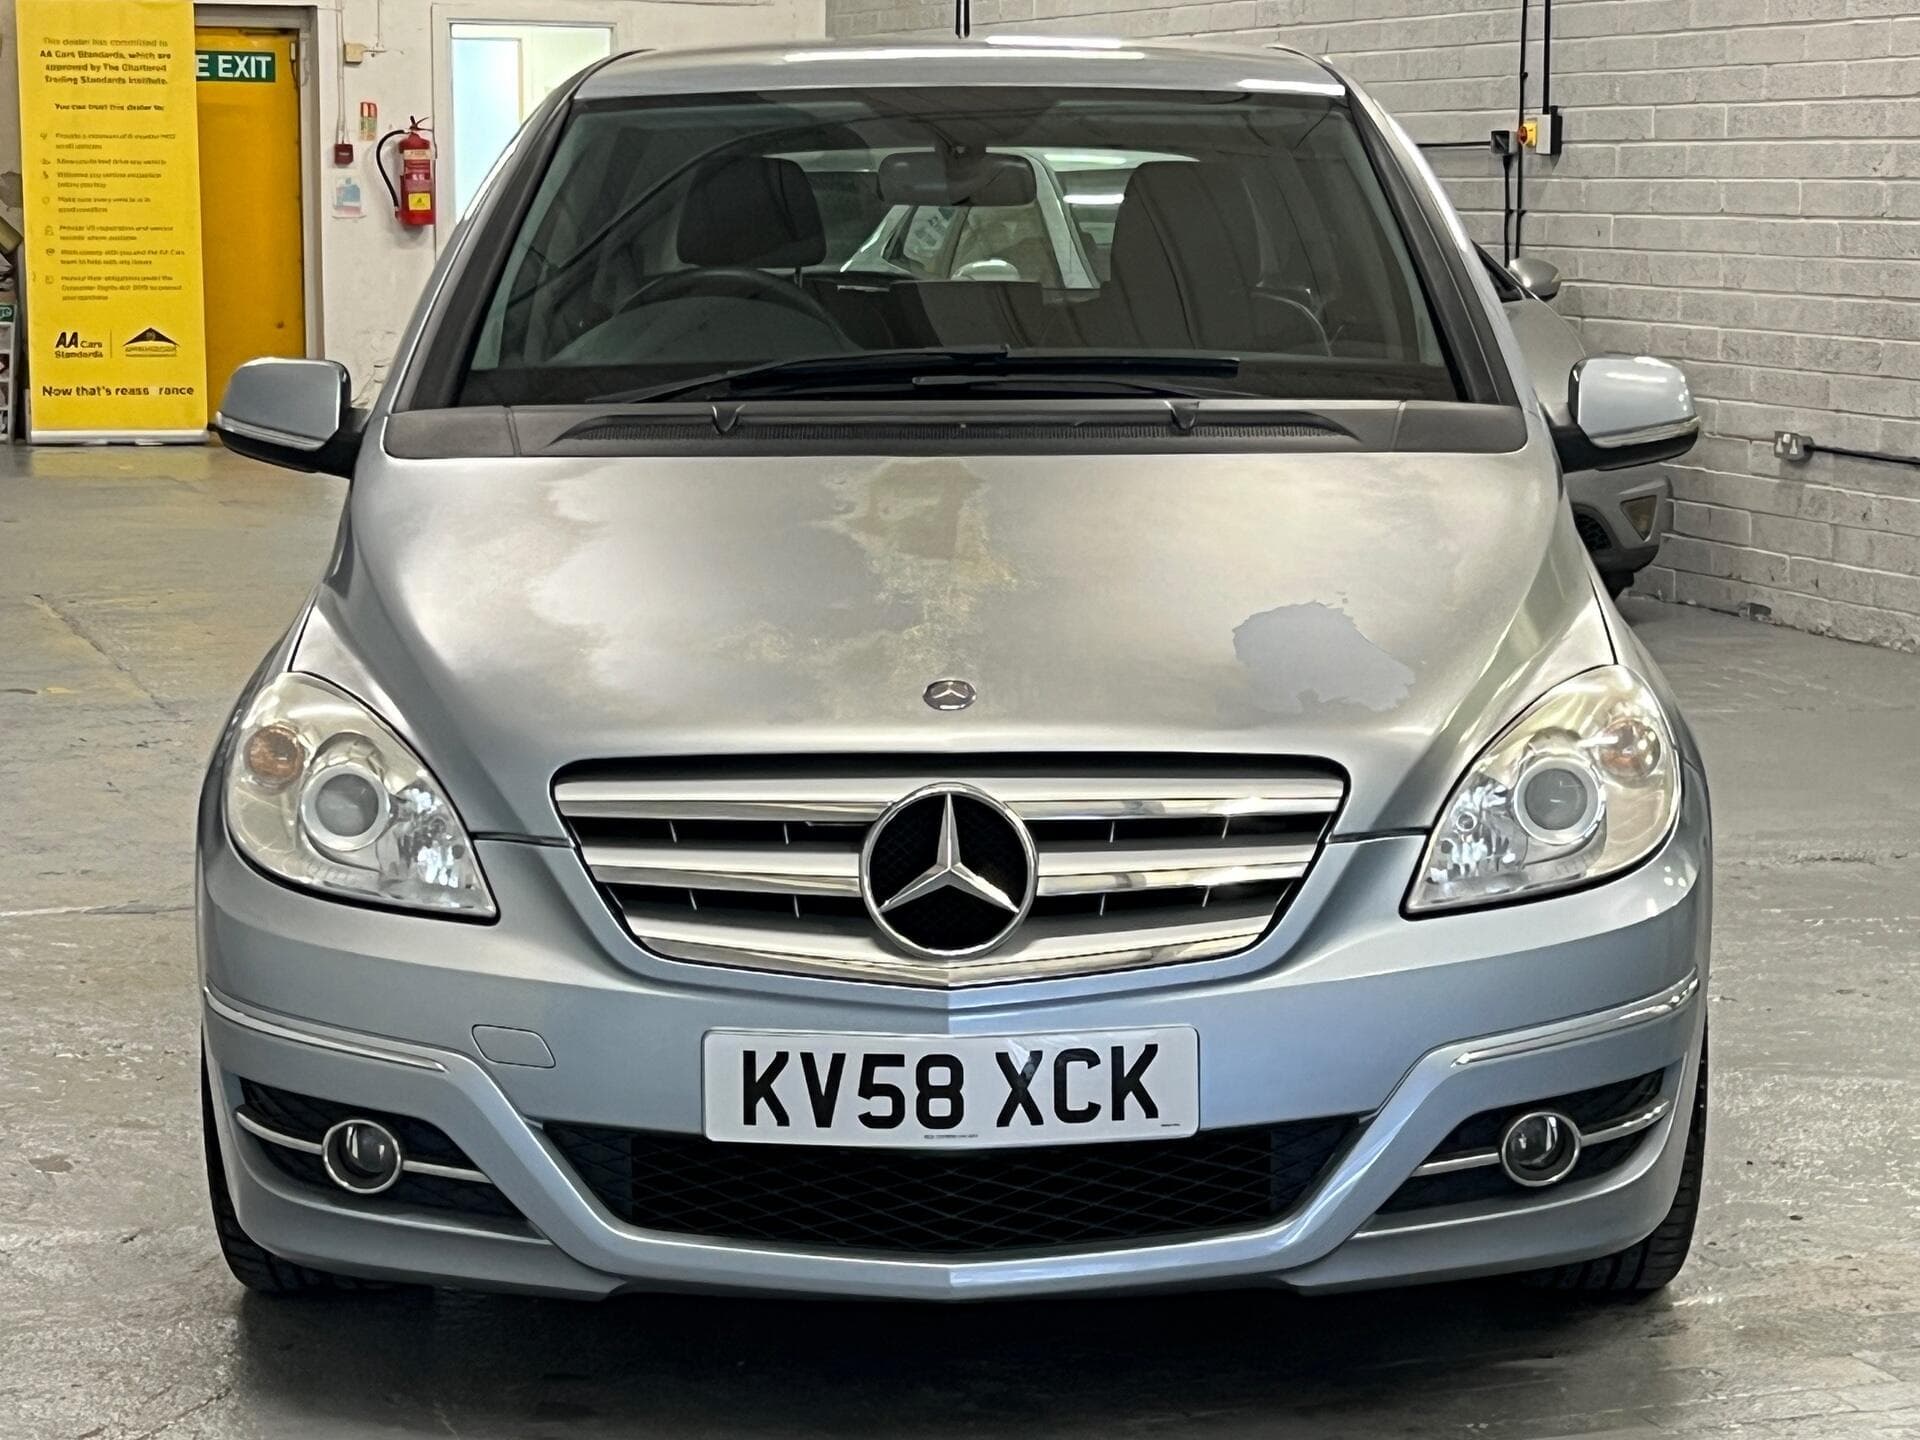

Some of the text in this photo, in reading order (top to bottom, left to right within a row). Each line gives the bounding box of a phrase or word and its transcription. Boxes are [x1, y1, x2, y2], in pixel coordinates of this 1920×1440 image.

[40, 50, 52, 59] AA
[55, 50, 75, 59] Cars
[90, 63, 100, 72] by
[103, 63, 119, 72] The
[218, 54, 272, 78] EXIT
[80, 76, 126, 85] Standards
[55, 331, 103, 349] AA Cars
[42, 386, 194, 396] Now that's reassrance
[742, 1043, 1160, 1130] KV58 XCK
